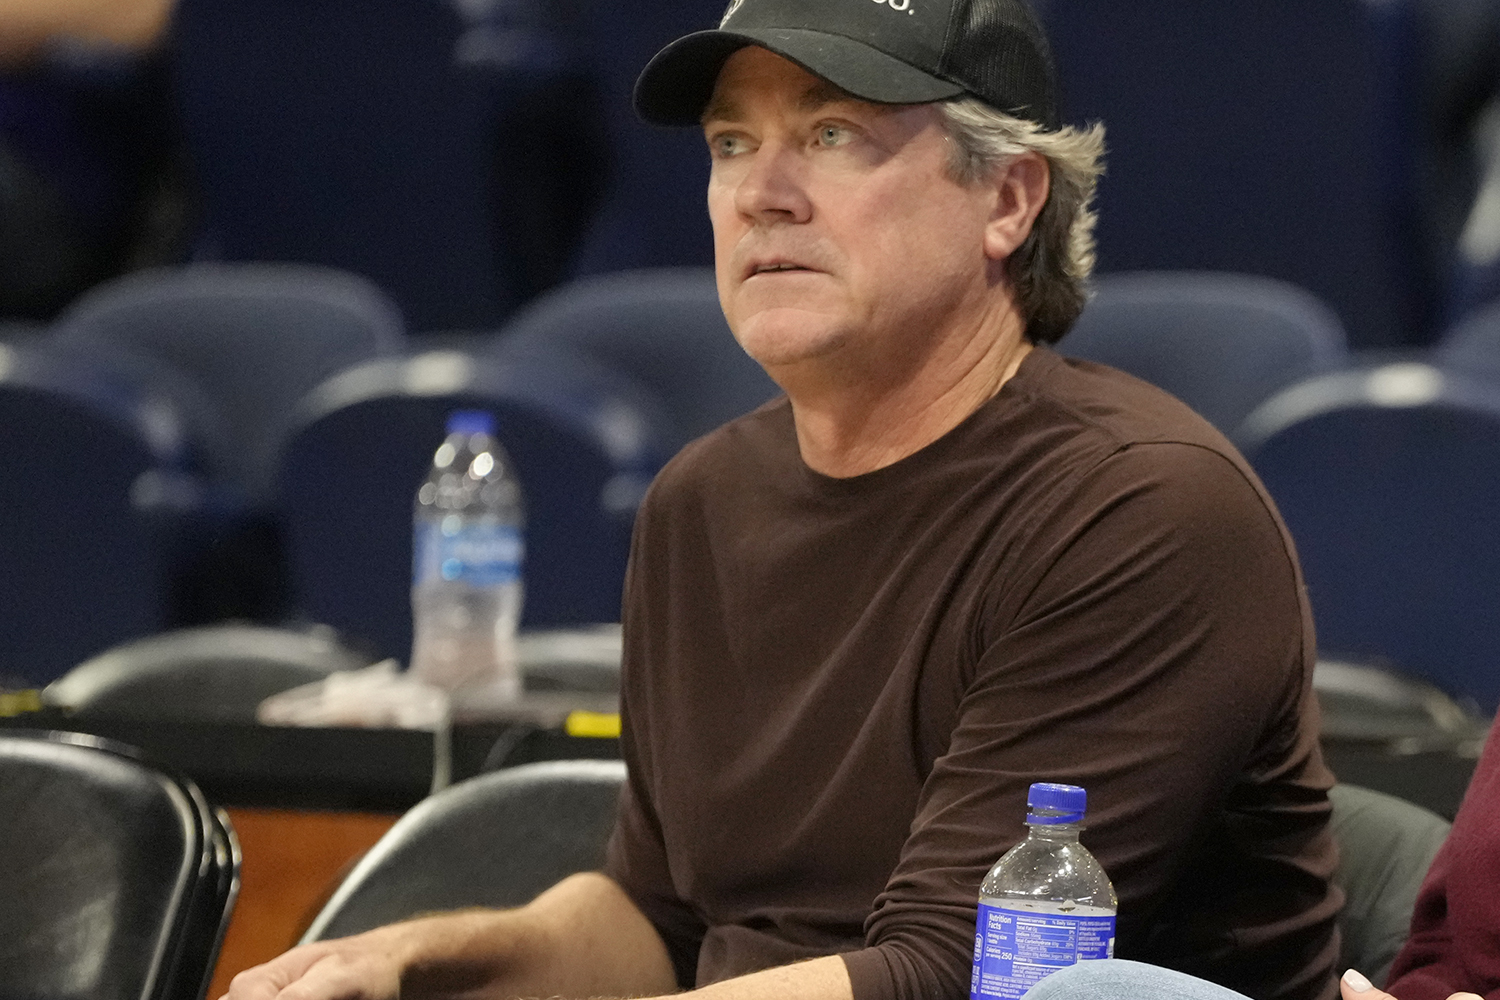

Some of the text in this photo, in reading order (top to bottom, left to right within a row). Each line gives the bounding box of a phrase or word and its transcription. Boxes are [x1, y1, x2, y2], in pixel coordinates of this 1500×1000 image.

[988, 913, 1012, 924] Nutrition
[988, 920, 1002, 930] Facts
[1001, 952, 1013, 961] 250
